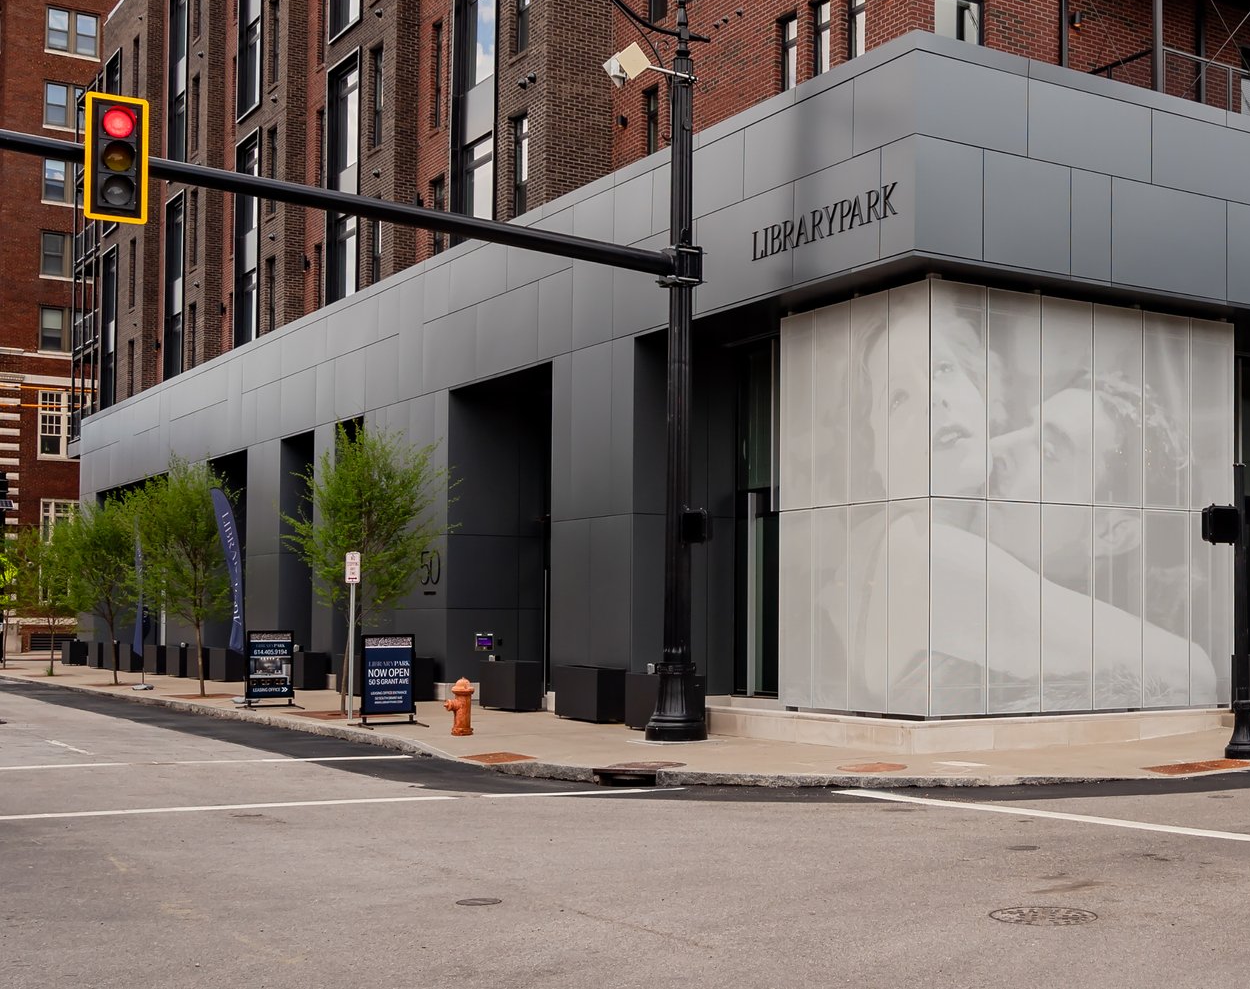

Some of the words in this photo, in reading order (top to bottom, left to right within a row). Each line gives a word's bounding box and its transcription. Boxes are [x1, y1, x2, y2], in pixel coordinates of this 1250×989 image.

[751, 181, 899, 262] LIBRARYPARK
[420, 550, 441, 585] 50
[368, 668, 388, 678] NOW
[388, 668, 410, 678] OPEN
